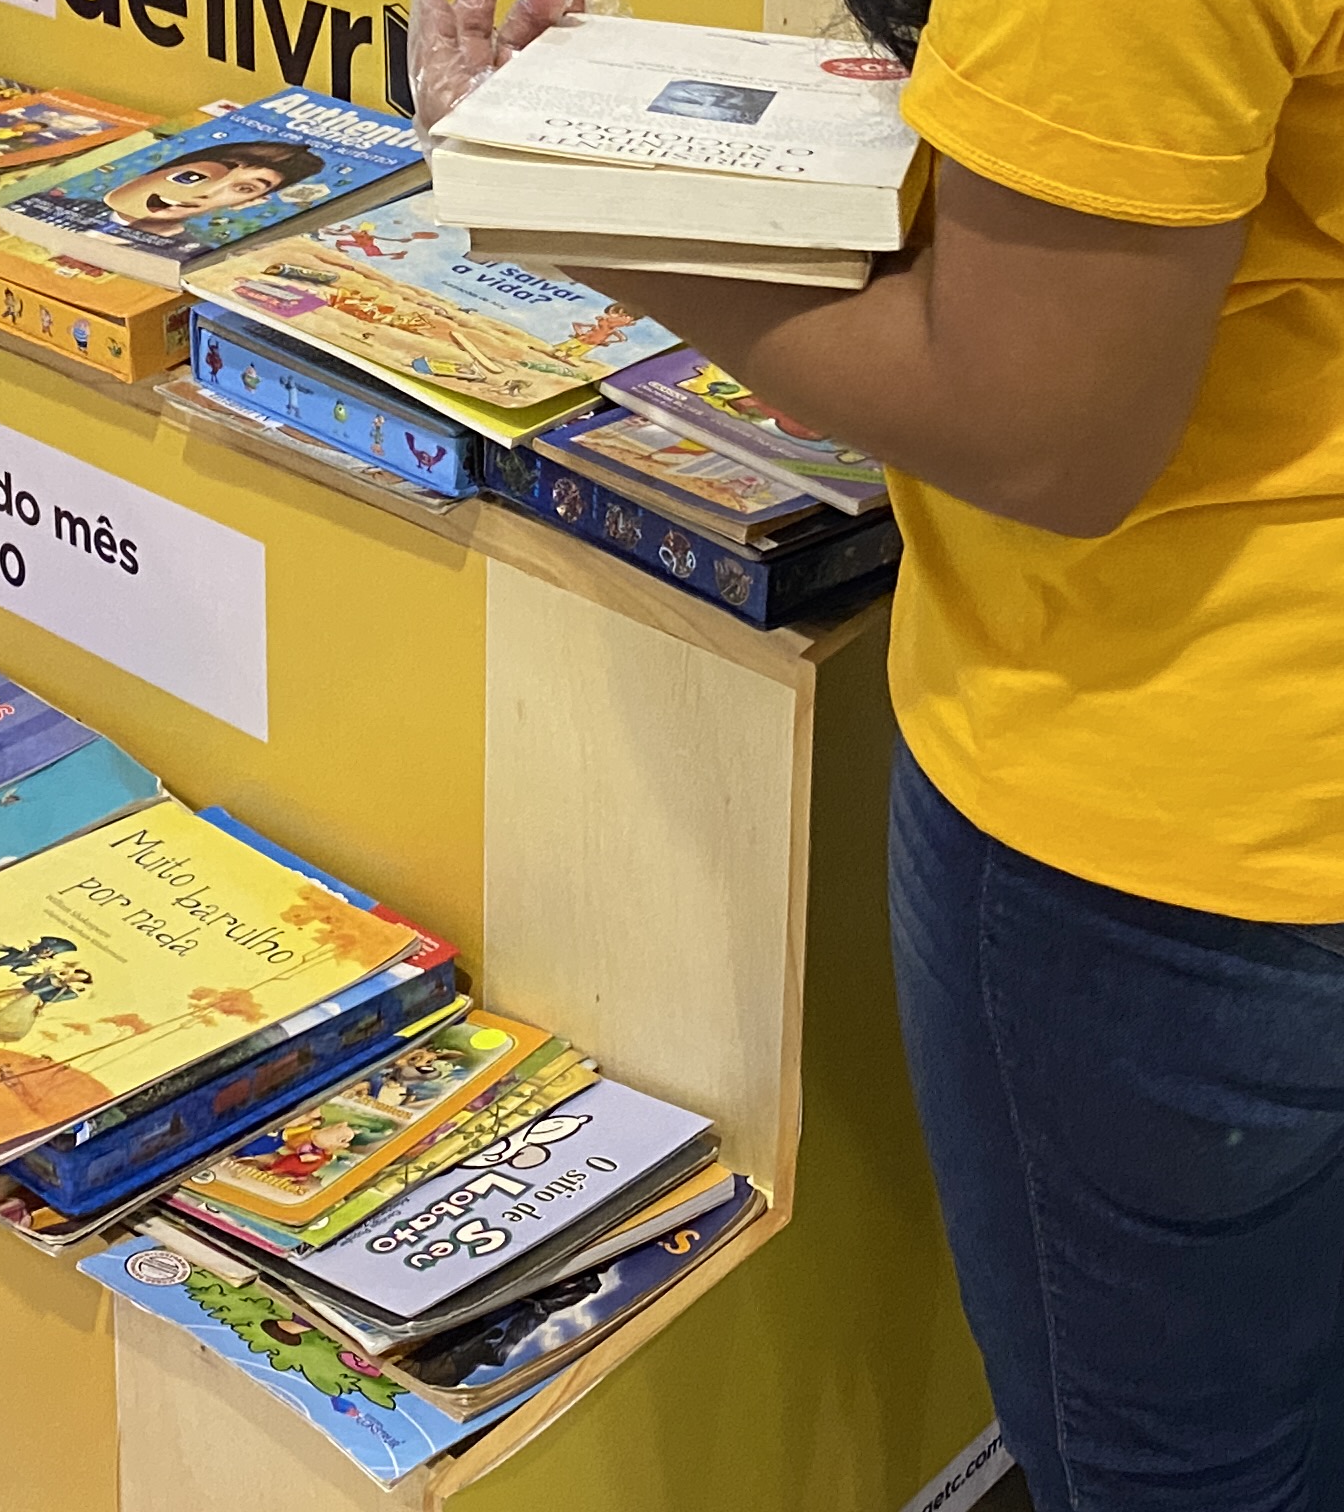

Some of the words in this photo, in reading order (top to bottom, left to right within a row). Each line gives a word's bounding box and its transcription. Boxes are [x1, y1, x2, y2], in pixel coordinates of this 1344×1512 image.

[451, 264, 473, 275] a
[476, 272, 554, 304] vida?
[499, 267, 586, 303] salvar
[53, 503, 139, 576] mês
[57, 876, 132, 907] por
[122, 908, 201, 958] nada
[108, 828, 196, 888] Muito
[170, 885, 295, 965] barulho
[533, 1168, 588, 1205] sítio
[585, 1156, 618, 1173] O
[366, 1169, 535, 1254] Lobato
[501, 1204, 543, 1222] de
[406, 1218, 512, 1272] Seu
